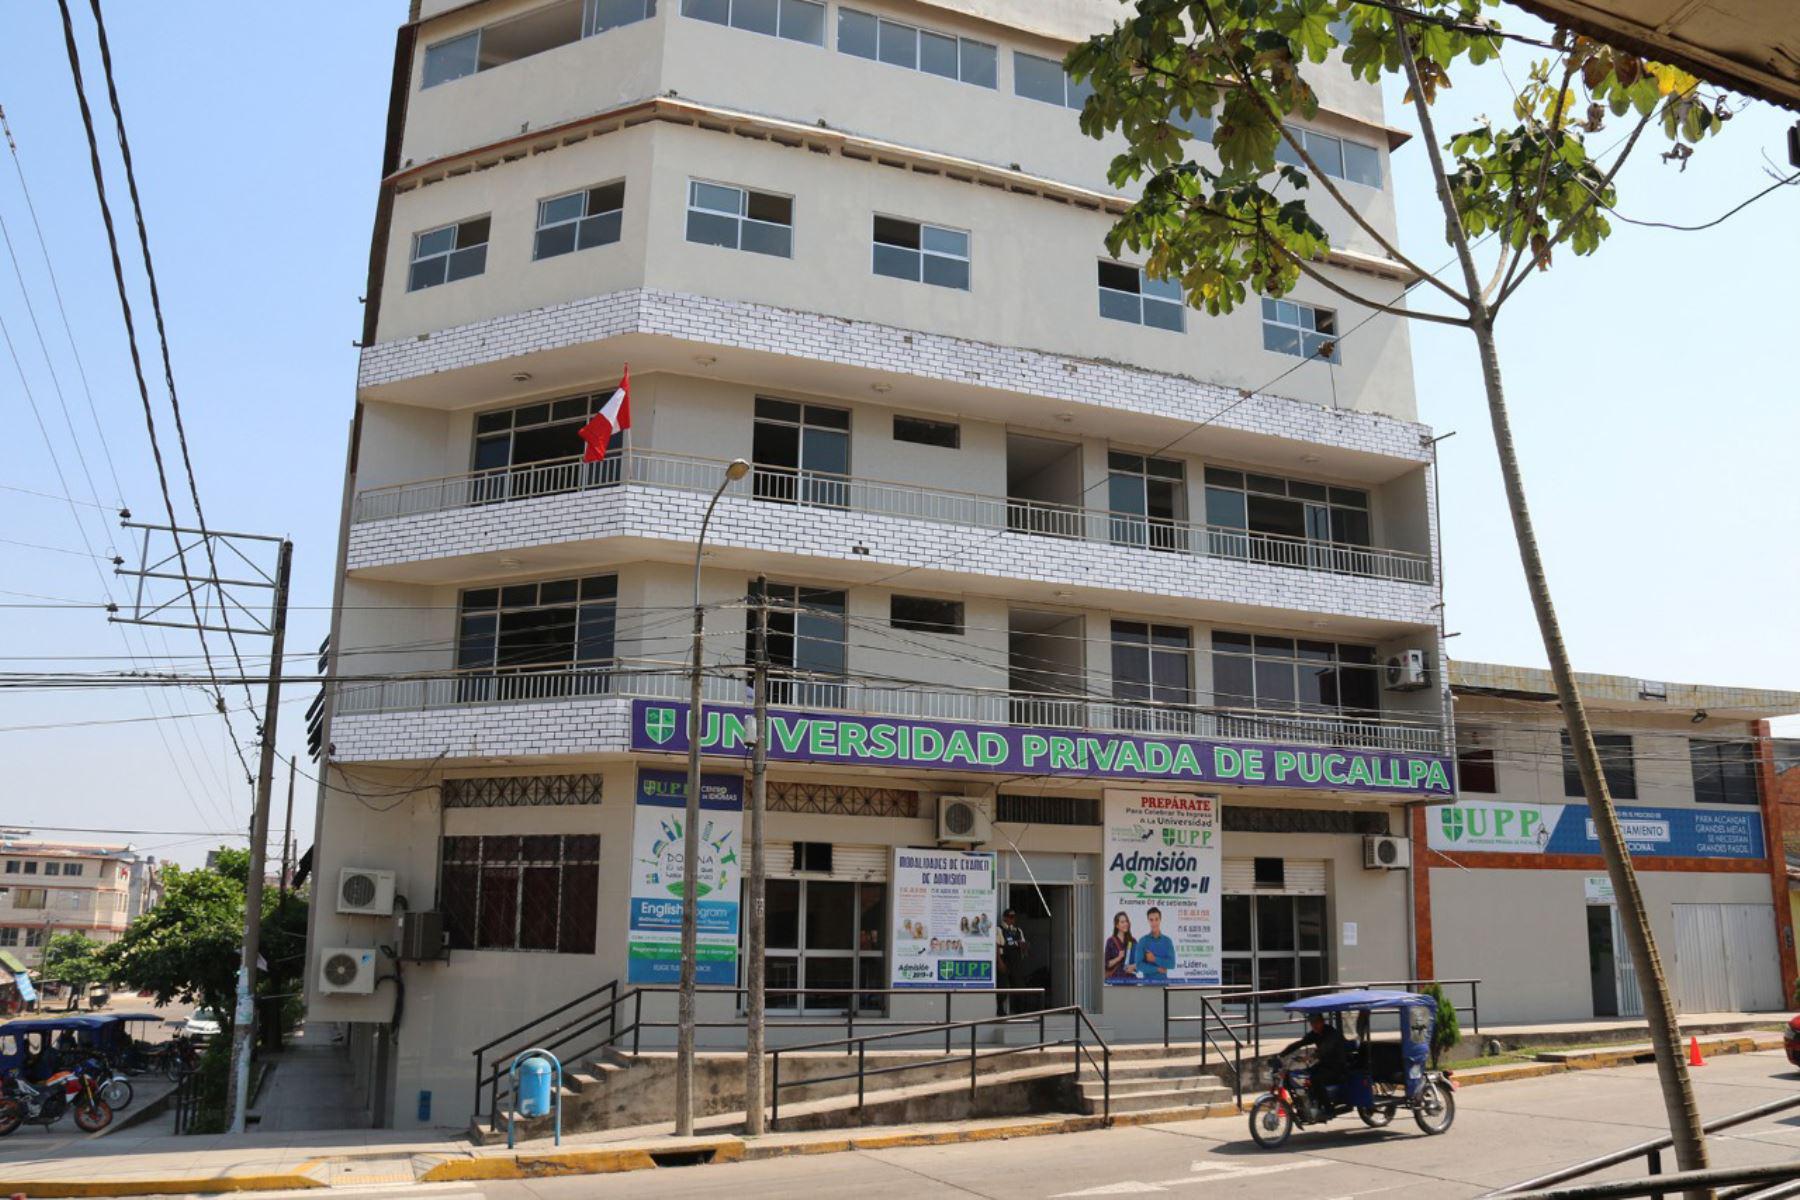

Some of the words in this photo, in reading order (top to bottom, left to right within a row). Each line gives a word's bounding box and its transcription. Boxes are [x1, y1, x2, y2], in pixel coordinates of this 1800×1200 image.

[1022, 734, 1202, 776] PRIVADA
[1214, 746, 1265, 780] DE
[1274, 750, 1451, 790] PUCALLPA
[1141, 795, 1212, 811] PREPÁRATE
[1157, 816, 1212, 828] Universidad
[1466, 807, 1540, 838] UPP
[1695, 815, 1713, 823] PARA
[1713, 815, 1747, 824] ALCANZAR
[1177, 830, 1212, 845] UPP
[667, 852, 714, 865] DONA
[1109, 850, 1198, 871] Admisión
[641, 901, 684, 918] English
[955, 961, 990, 977] UPP
